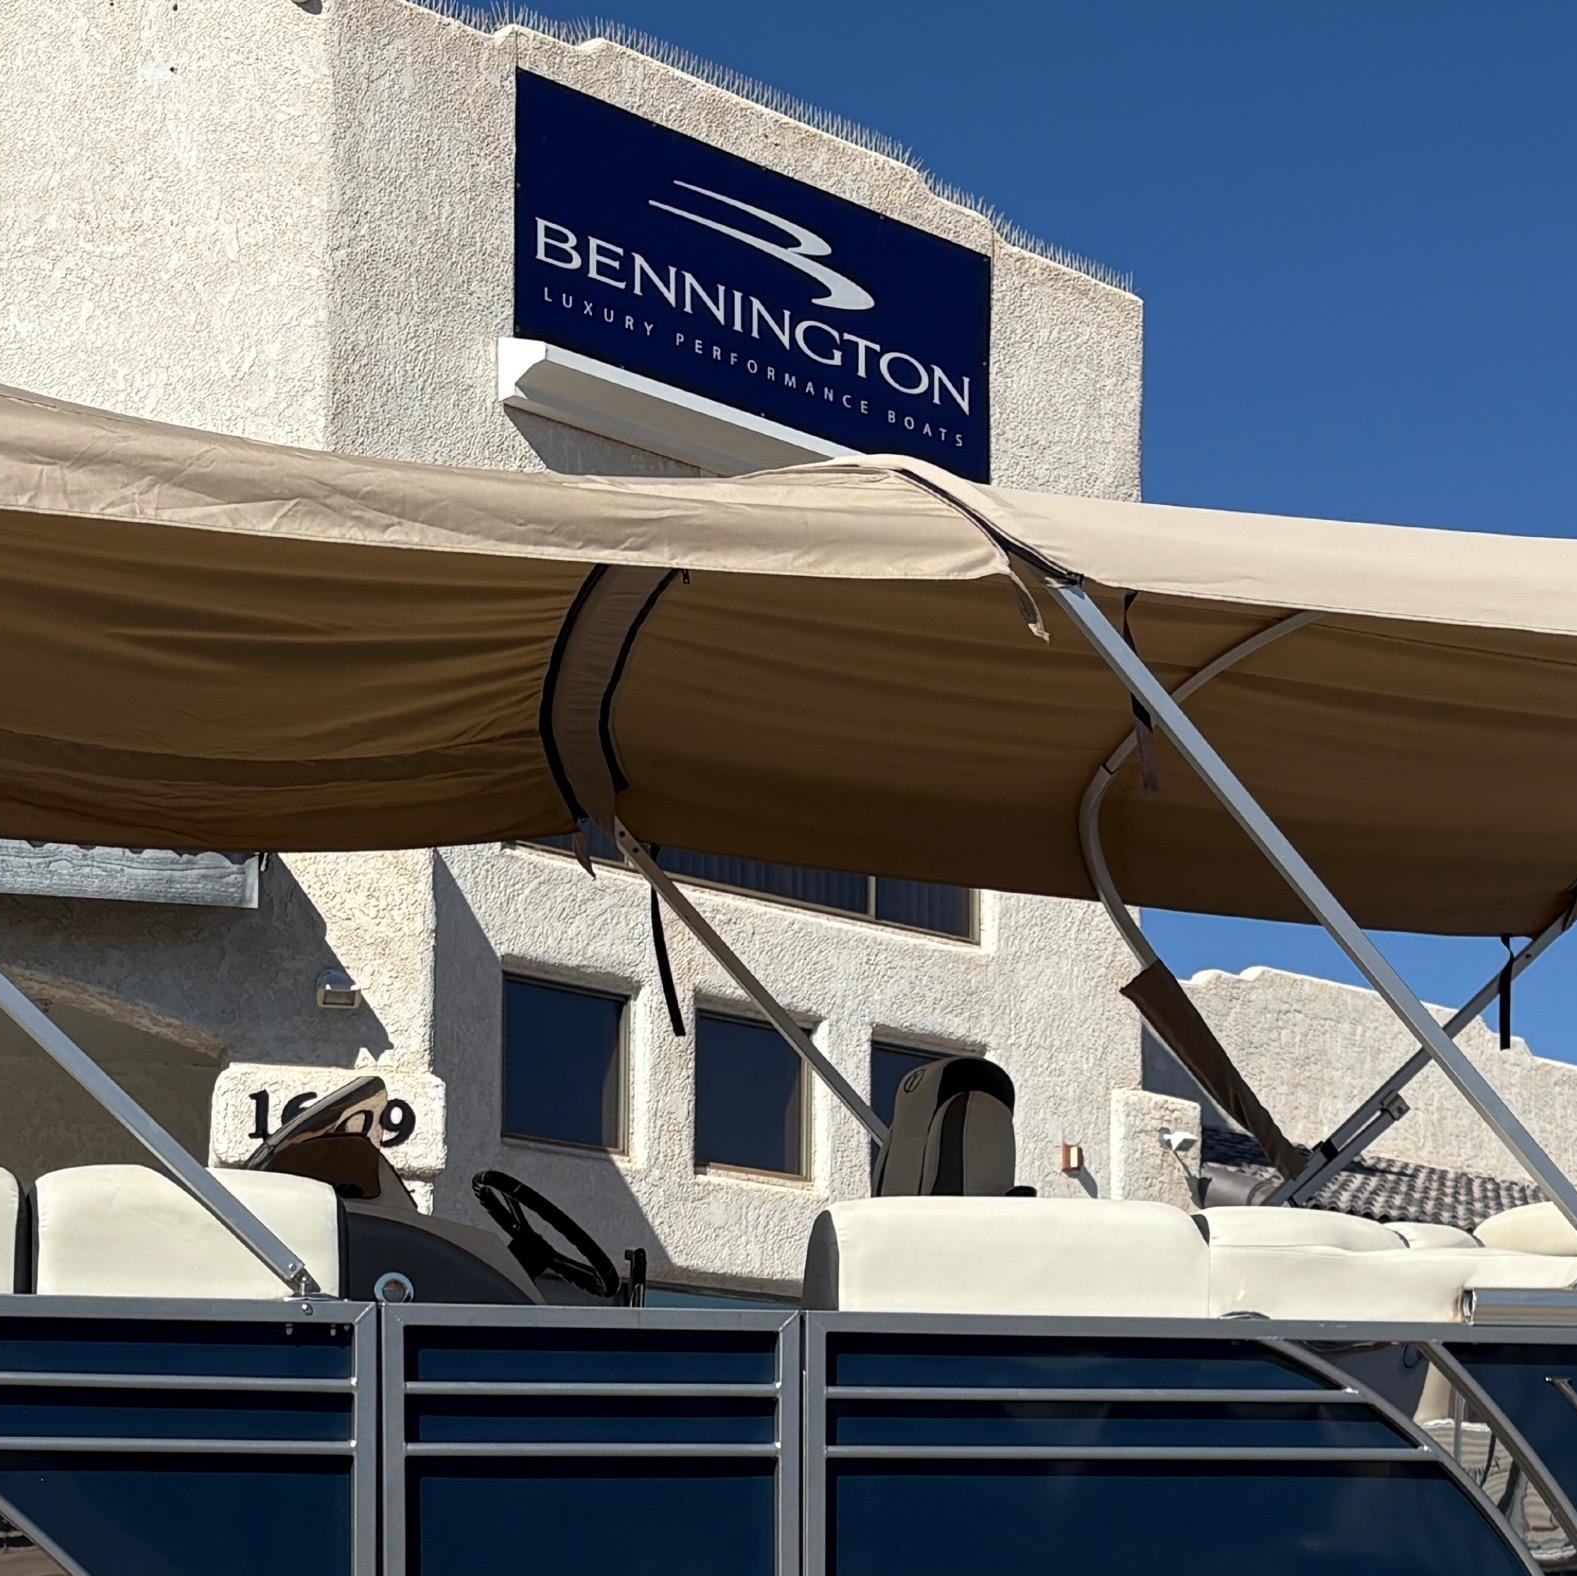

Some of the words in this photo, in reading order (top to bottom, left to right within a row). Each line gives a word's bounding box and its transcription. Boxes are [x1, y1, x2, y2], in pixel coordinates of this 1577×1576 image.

[534, 217, 971, 416] BENNINGTON
[543, 286, 655, 337] LUXURY
[676, 333, 870, 415] PERFORMANCE
[887, 410, 964, 448] BOATS
